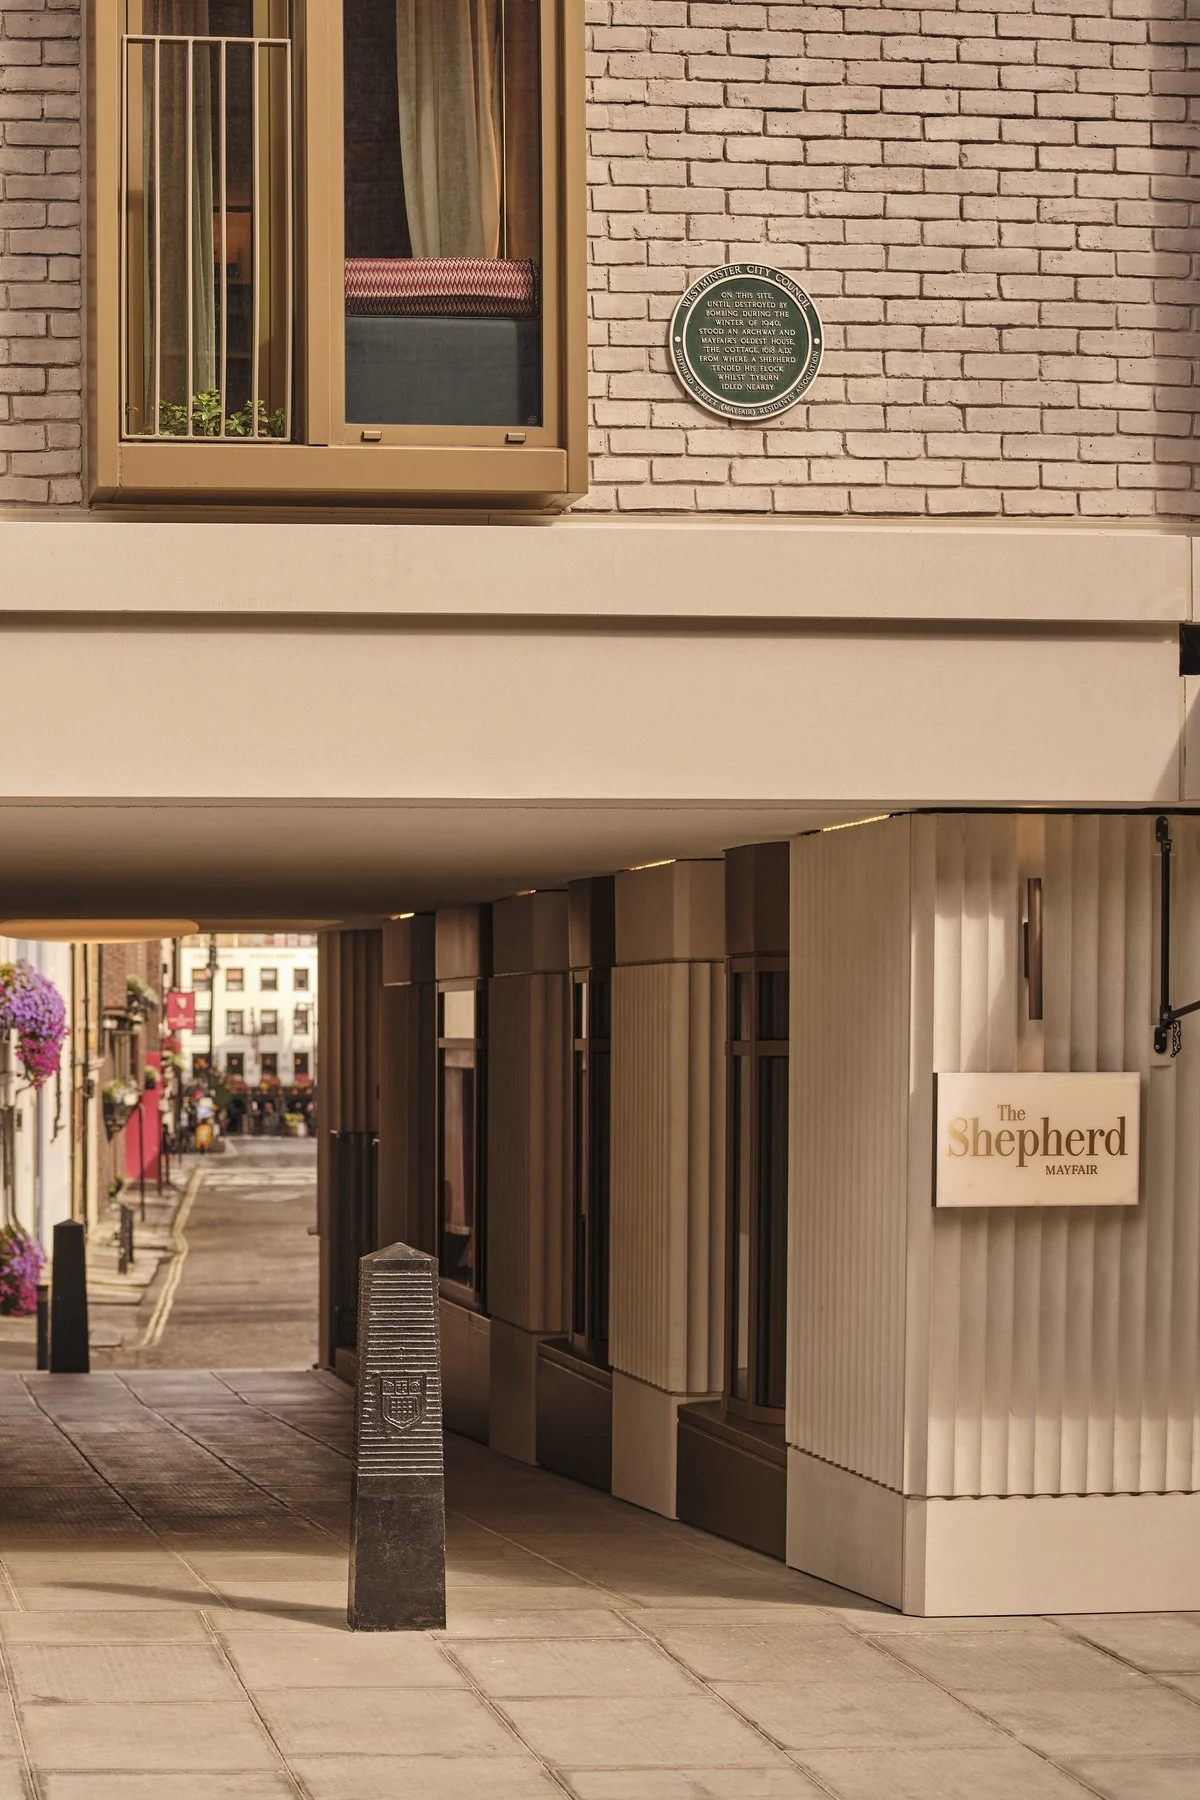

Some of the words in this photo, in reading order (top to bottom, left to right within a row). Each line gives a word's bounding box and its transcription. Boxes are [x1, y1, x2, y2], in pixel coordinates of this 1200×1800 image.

[681, 265, 742, 309] WESTMINSTER
[746, 265, 772, 277] CITY
[775, 273, 812, 311] COUNCIL
[720, 291, 733, 299] ON
[734, 301, 776, 309] DESTROYED
[774, 310, 790, 318] THE
[748, 319, 758, 327] OF
[771, 338, 796, 346] HOUSE,
[722, 355, 748, 363] WHERE
[675, 349, 695, 385] SHEPHERD
[693, 386, 718, 407] STREET
[720, 404, 756, 416] (MAYFAIR)
[795, 350, 819, 395] ASSOCIATION
[746, 383, 774, 391] NEARBY
[997, 1104, 1026, 1121] The
[948, 1115, 1128, 1168] Shepherd
[1045, 1164, 1098, 1175] MAYFAIR
